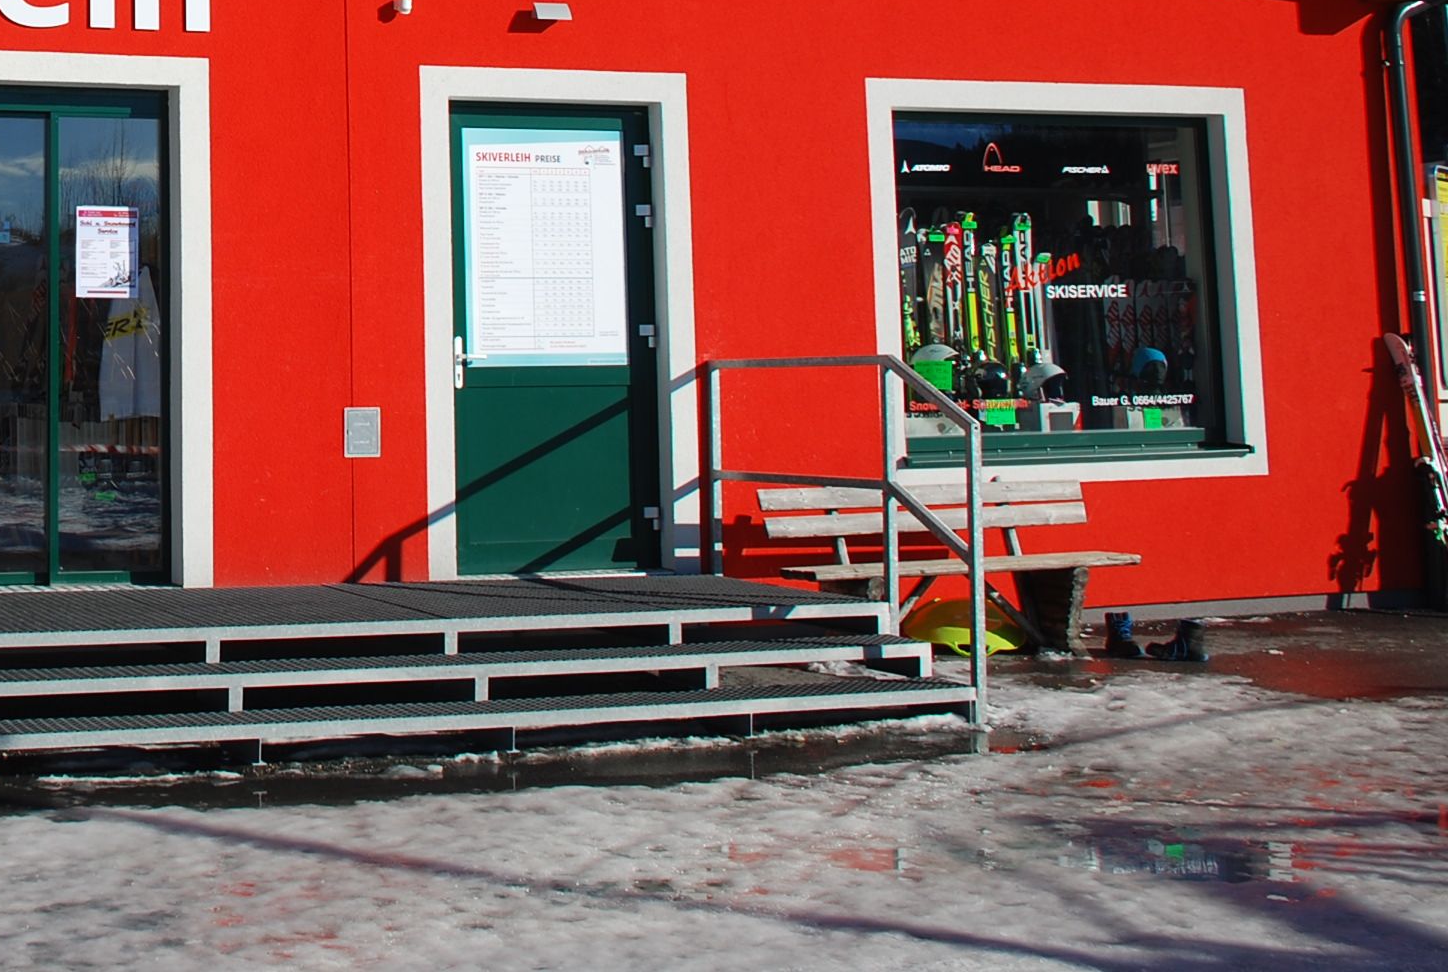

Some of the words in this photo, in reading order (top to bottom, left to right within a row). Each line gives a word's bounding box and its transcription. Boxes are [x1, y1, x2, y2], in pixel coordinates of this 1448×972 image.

[475, 152, 531, 162] SKIVERLEIH
[535, 155, 561, 163] PREISE
[963, 230, 976, 292] HEAD
[1005, 253, 1081, 301] Aktion
[1046, 284, 1128, 299] SKISERVICE
[978, 270, 998, 362] FISCHER
[1092, 396, 1119, 406] Bauer
[1120, 395, 1131, 405] G.
[1132, 394, 1195, 405] 0664/4425767
